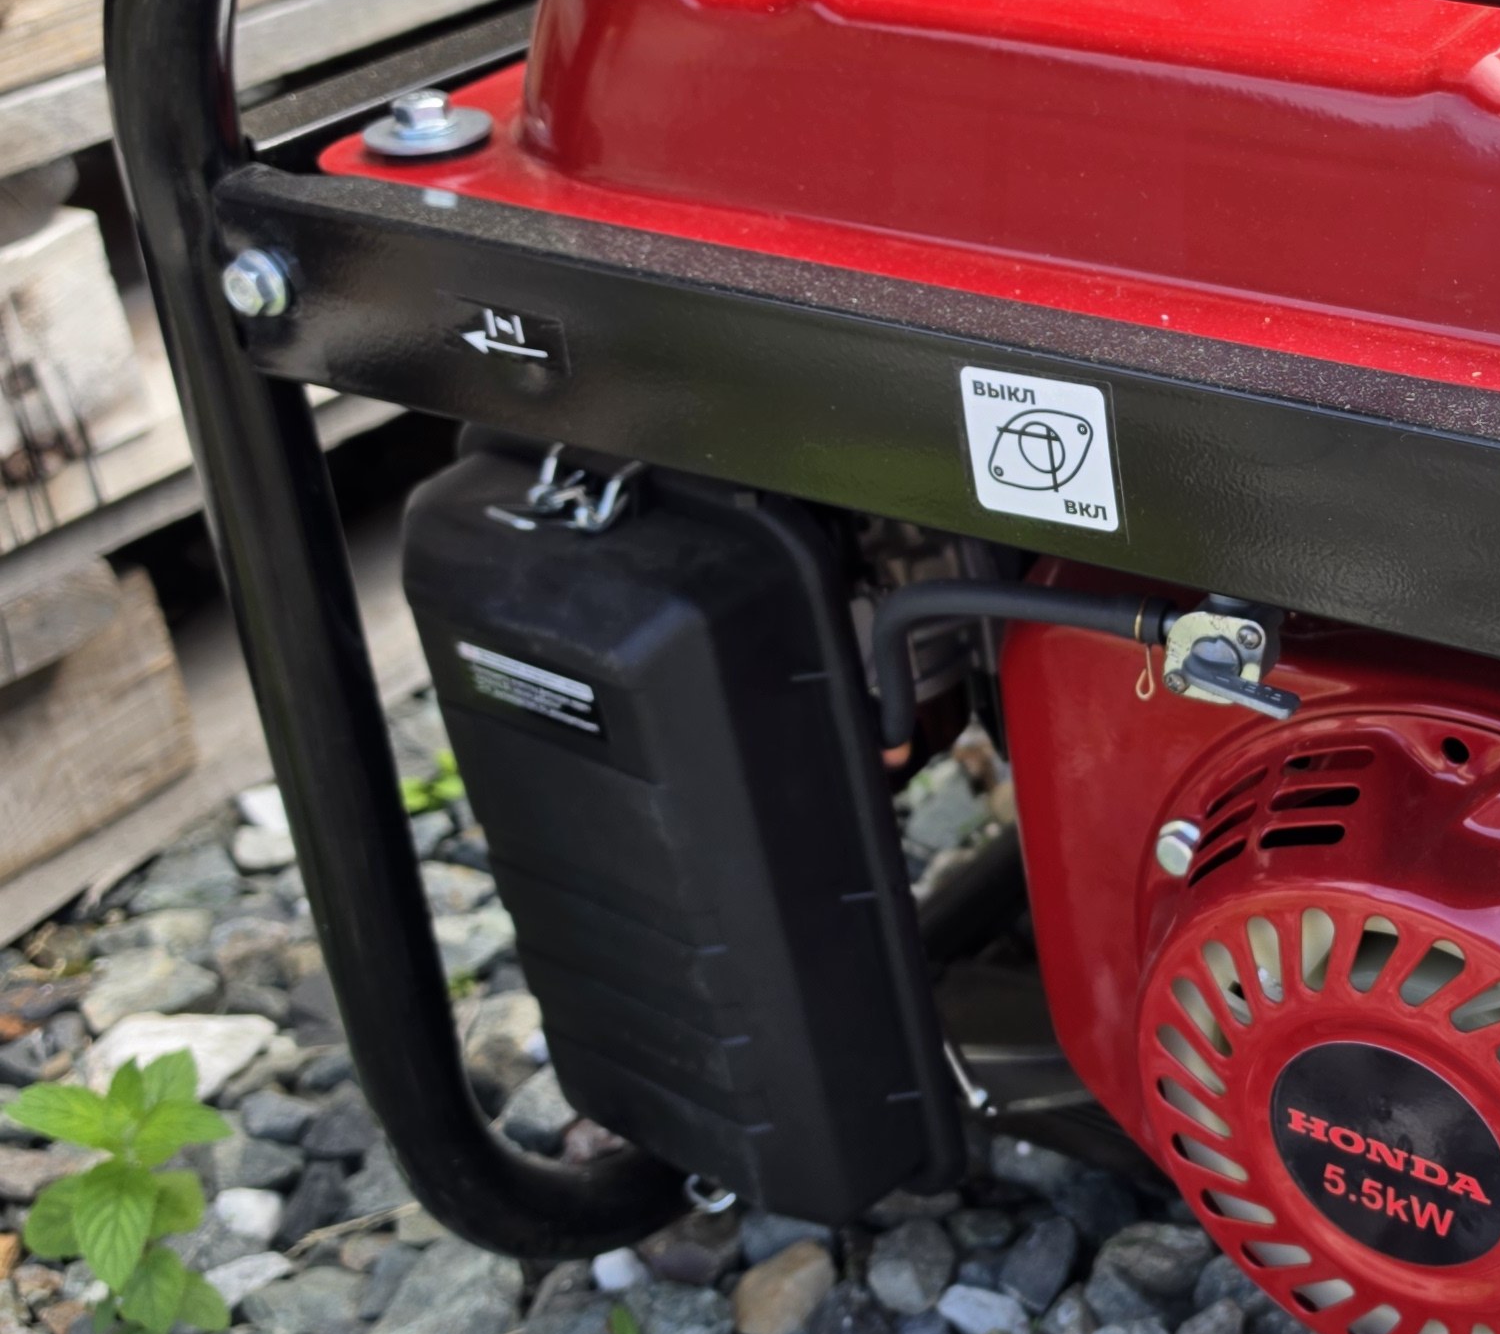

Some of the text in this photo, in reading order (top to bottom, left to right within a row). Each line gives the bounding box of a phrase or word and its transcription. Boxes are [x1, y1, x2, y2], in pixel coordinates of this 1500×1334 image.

[971, 379, 1037, 406] ВЫКЛ
[1063, 498, 1109, 521] ВКЛ
[1287, 1107, 1492, 1206] HONDA
[1323, 1162, 1454, 1238] 5.5kW
